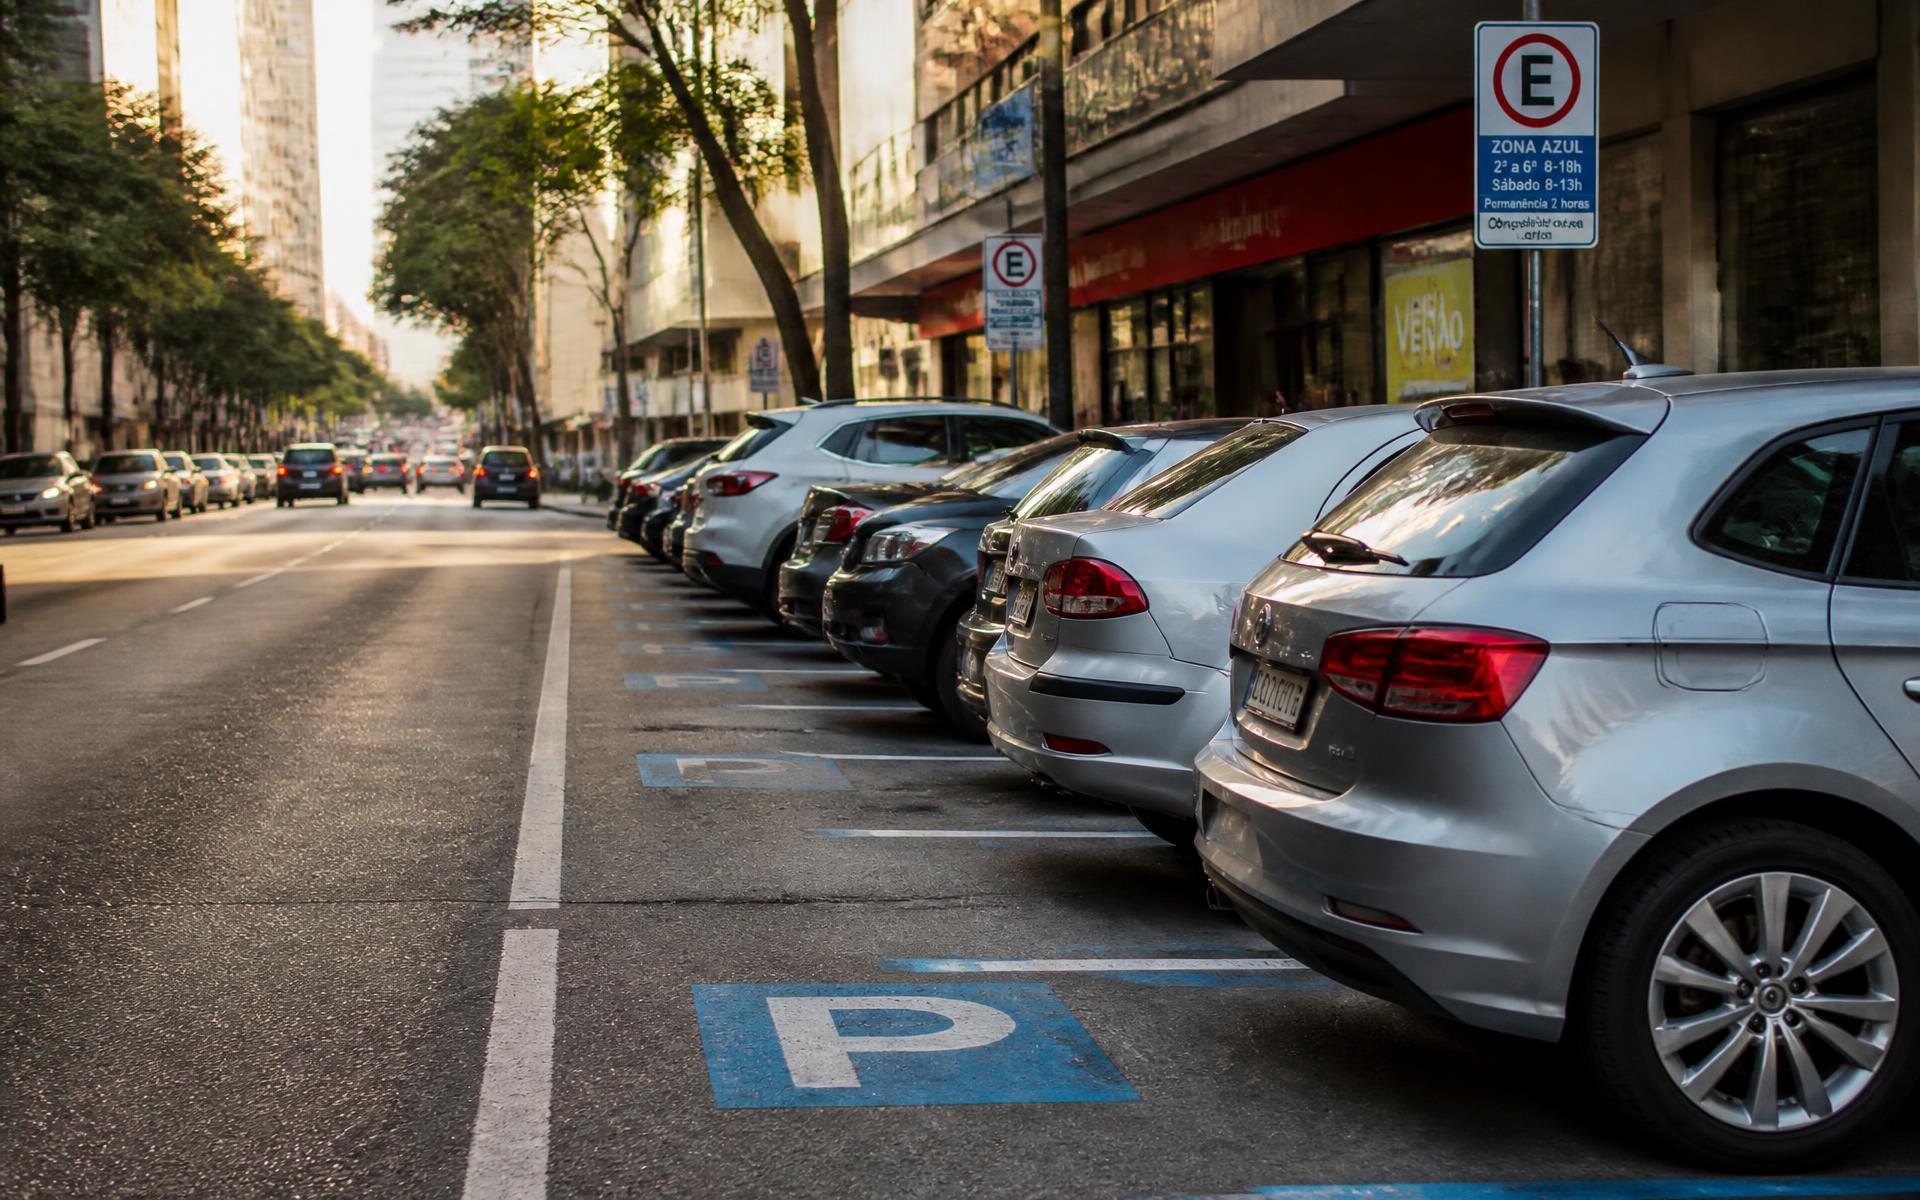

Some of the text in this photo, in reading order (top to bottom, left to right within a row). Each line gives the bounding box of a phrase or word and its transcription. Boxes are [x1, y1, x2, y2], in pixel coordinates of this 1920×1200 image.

[1521, 55, 1554, 106] E
[1491, 140, 1584, 154] ZONA AZUL
[1511, 163, 1520, 173] a
[1544, 160, 1582, 173] 8-18h
[1492, 178, 1583, 191] Sábado 8-13h
[1551, 198, 1558, 209] 2
[1560, 198, 1590, 209] horas
[1006, 251, 1025, 277] E
[676, 758, 800, 783] P
[766, 996, 1016, 1088] P
